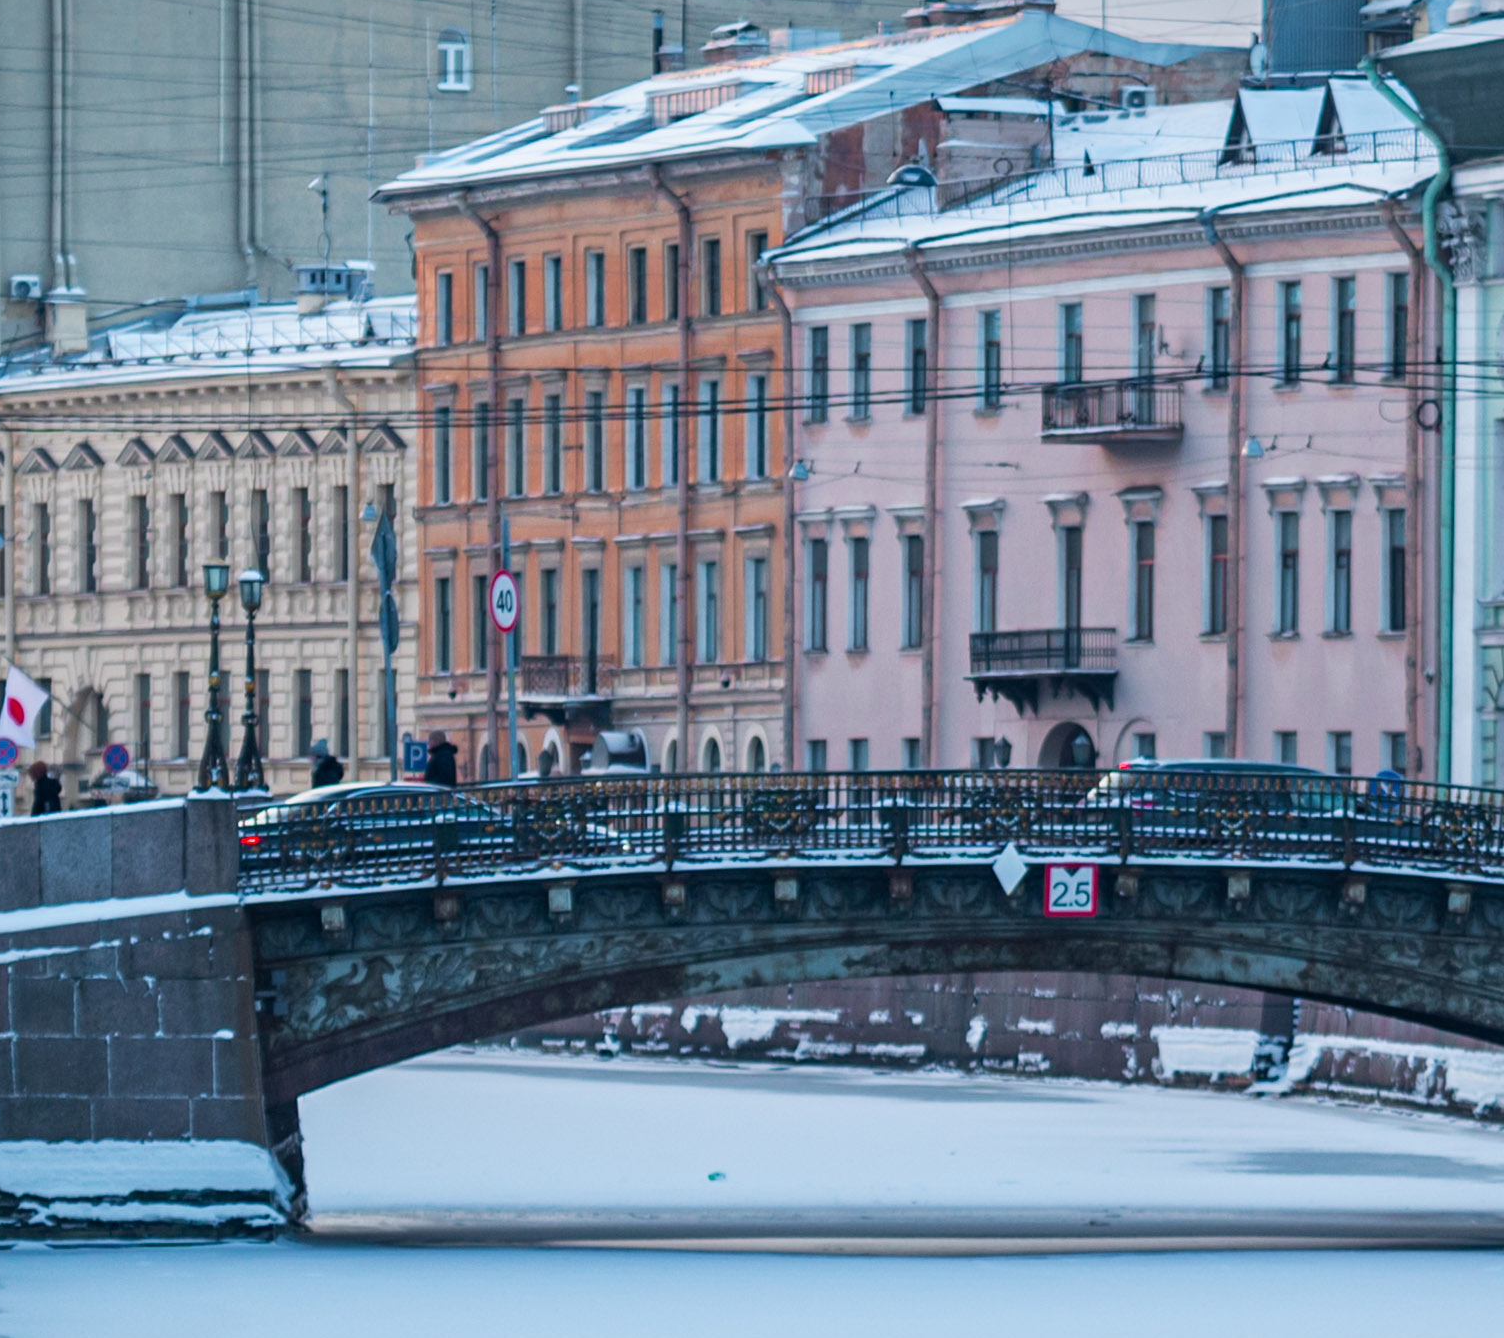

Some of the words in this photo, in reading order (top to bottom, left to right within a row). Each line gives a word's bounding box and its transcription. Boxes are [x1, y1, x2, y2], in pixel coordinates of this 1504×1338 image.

[496, 589, 513, 613] 40
[410, 745, 423, 769] P
[1052, 881, 1090, 907] 2.5
